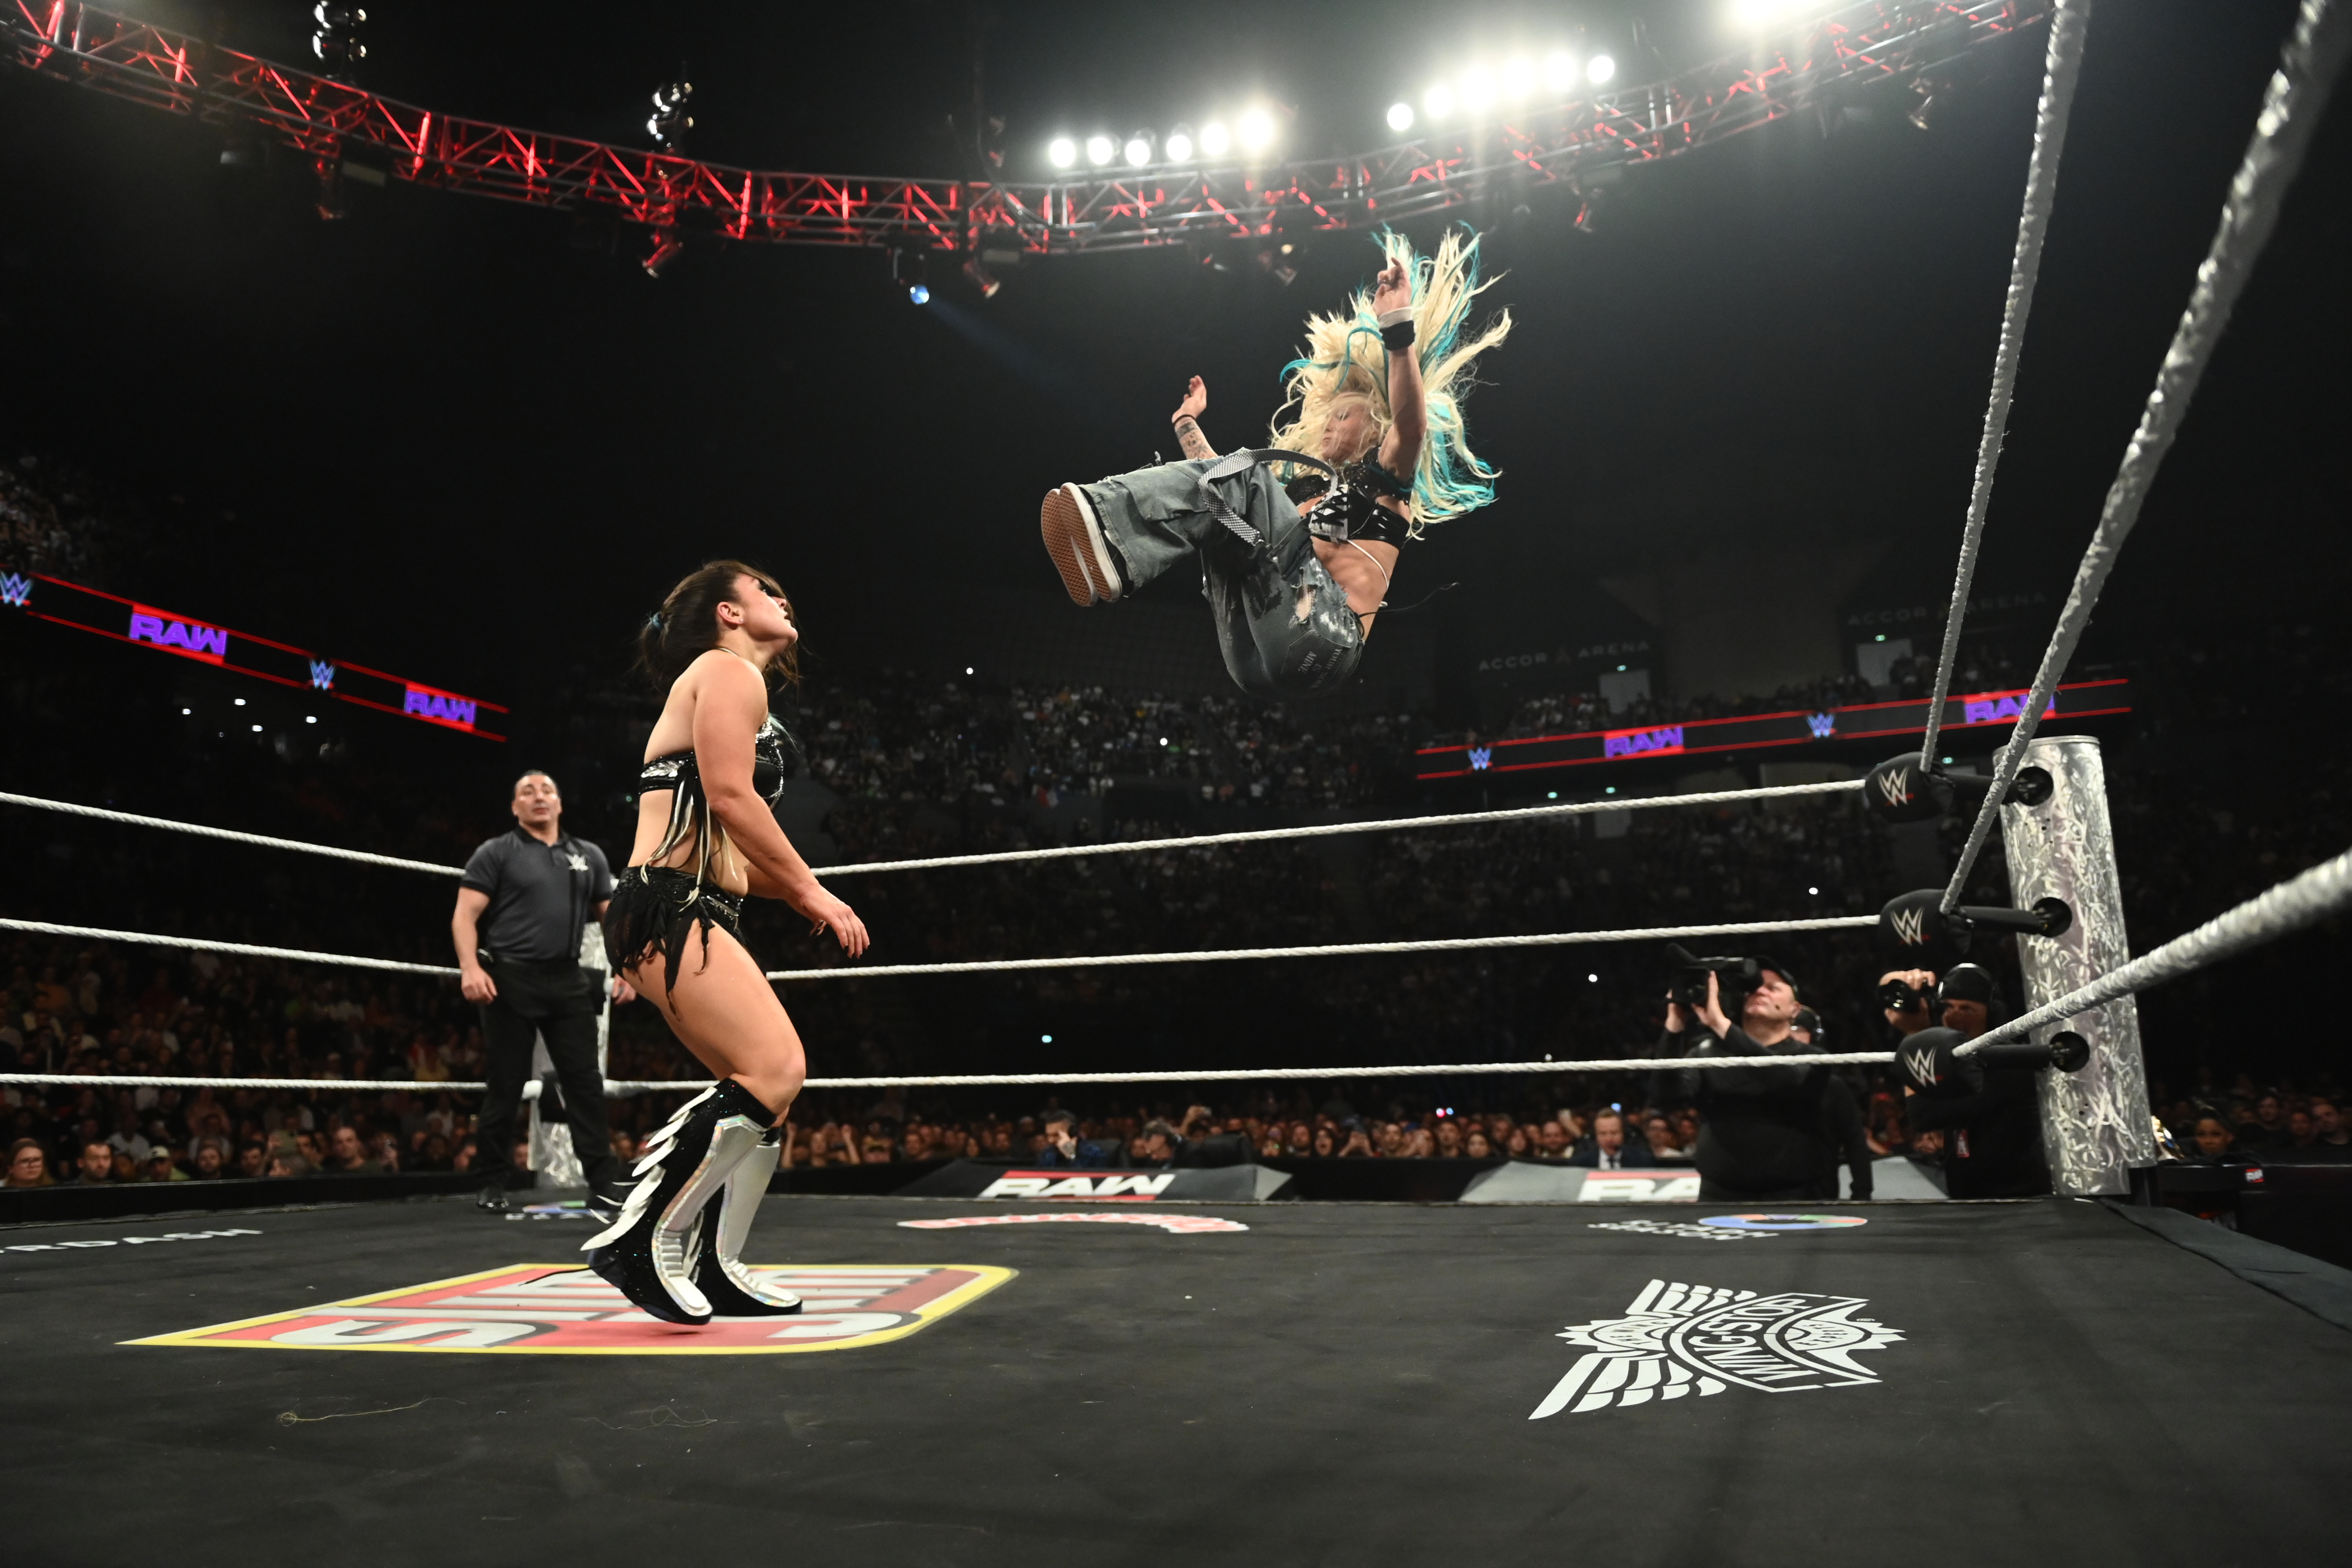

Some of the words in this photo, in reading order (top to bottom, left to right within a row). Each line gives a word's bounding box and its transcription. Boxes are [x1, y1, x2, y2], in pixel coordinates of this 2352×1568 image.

[129, 612, 228, 657] RAW
[1298, 651, 1317, 675] MINE
[1325, 648, 1343, 670] YOUR
[1478, 652, 1548, 671] ACCOR
[1578, 640, 1650, 658] ARENA
[403, 690, 477, 725] RAW
[1603, 725, 1684, 759] RAW
[977, 1173, 1177, 1199] RAW
[0, 1228, 264, 1254] RDASH
[1609, 1334, 1652, 1344] THE
[1794, 1324, 1849, 1346] EXPERTS
